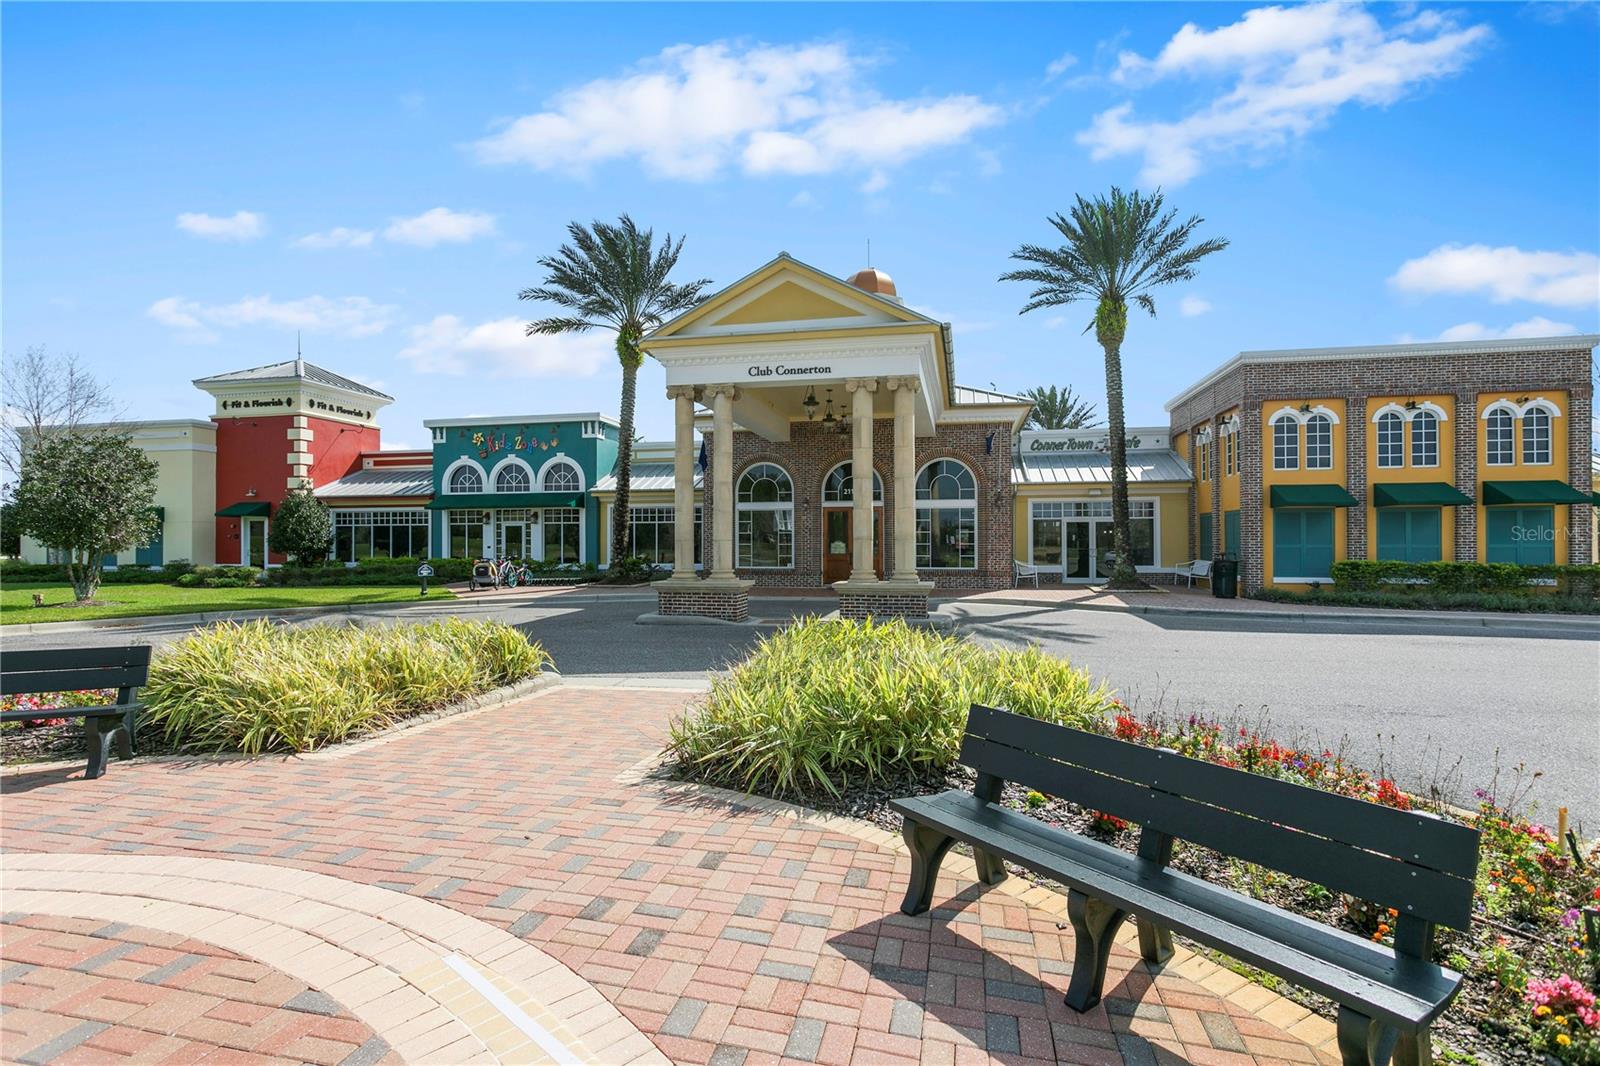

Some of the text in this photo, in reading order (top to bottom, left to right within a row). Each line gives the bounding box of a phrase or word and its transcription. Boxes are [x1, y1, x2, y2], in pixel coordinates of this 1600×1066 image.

[748, 365, 832, 377] Club Connerton
[231, 398, 283, 408] Fit & Flourish
[317, 401, 364, 418] Fit & Flourish
[515, 435, 538, 454] Zone
